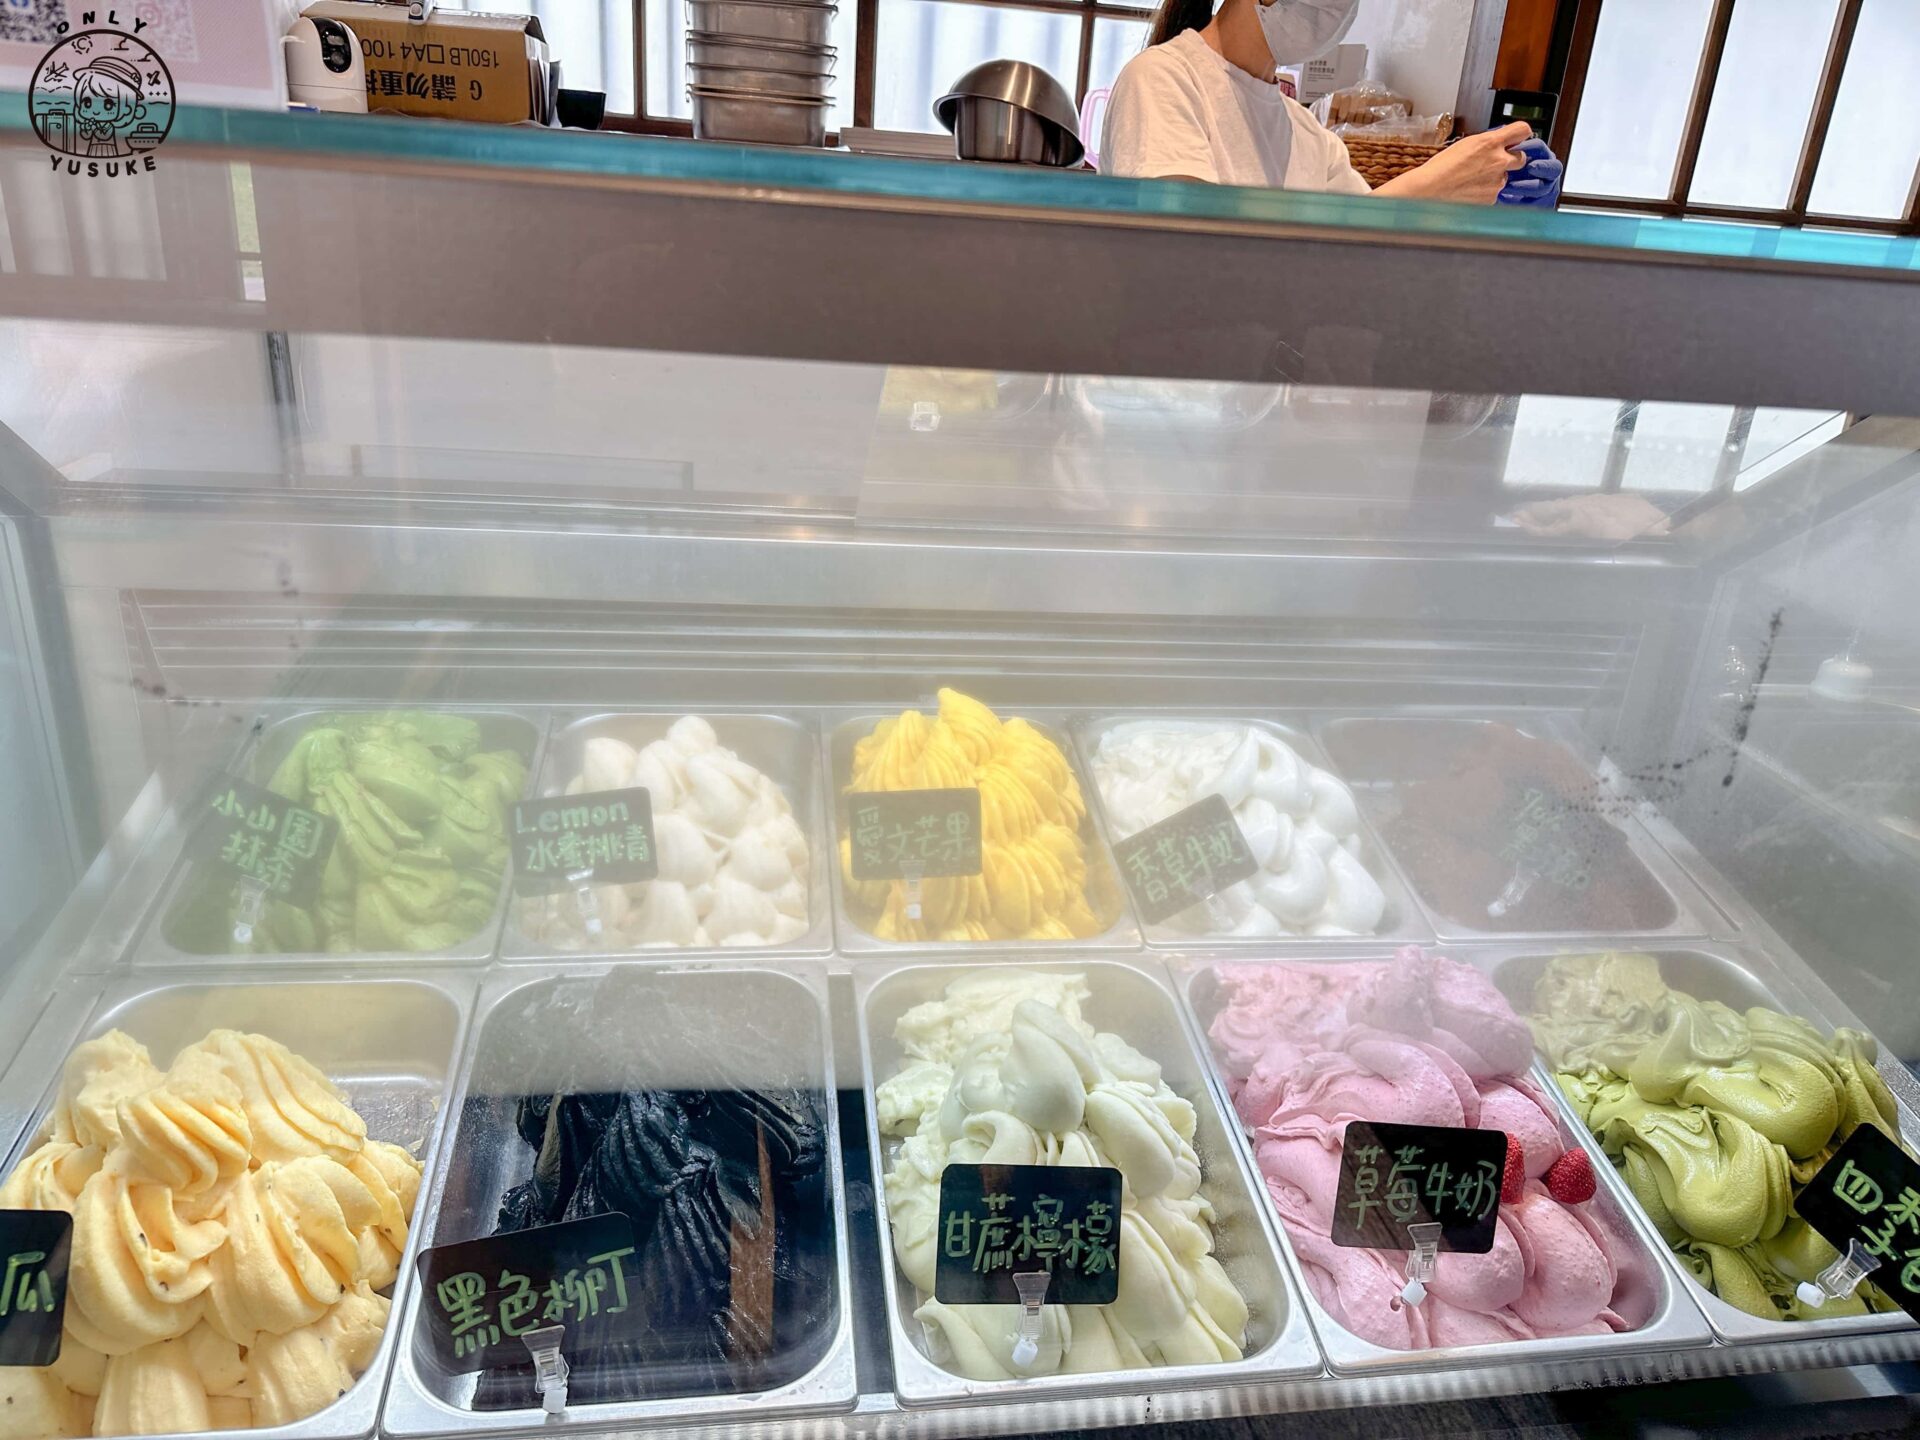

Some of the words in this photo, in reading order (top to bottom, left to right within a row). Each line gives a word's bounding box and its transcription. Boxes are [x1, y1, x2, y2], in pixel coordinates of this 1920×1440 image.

[450, 47, 499, 68] 150LB
[469, 79, 483, 101] G
[211, 789, 324, 859] 小山園
[516, 802, 630, 834] Lemon
[221, 829, 296, 893] 抹茶
[1126, 820, 1250, 902] 香草牛奶
[1348, 1145, 1498, 1230] 草莓牛奶
[945, 1193, 1117, 1275] 甘蔗檸檬
[437, 1246, 635, 1359] 黑色柳丁
